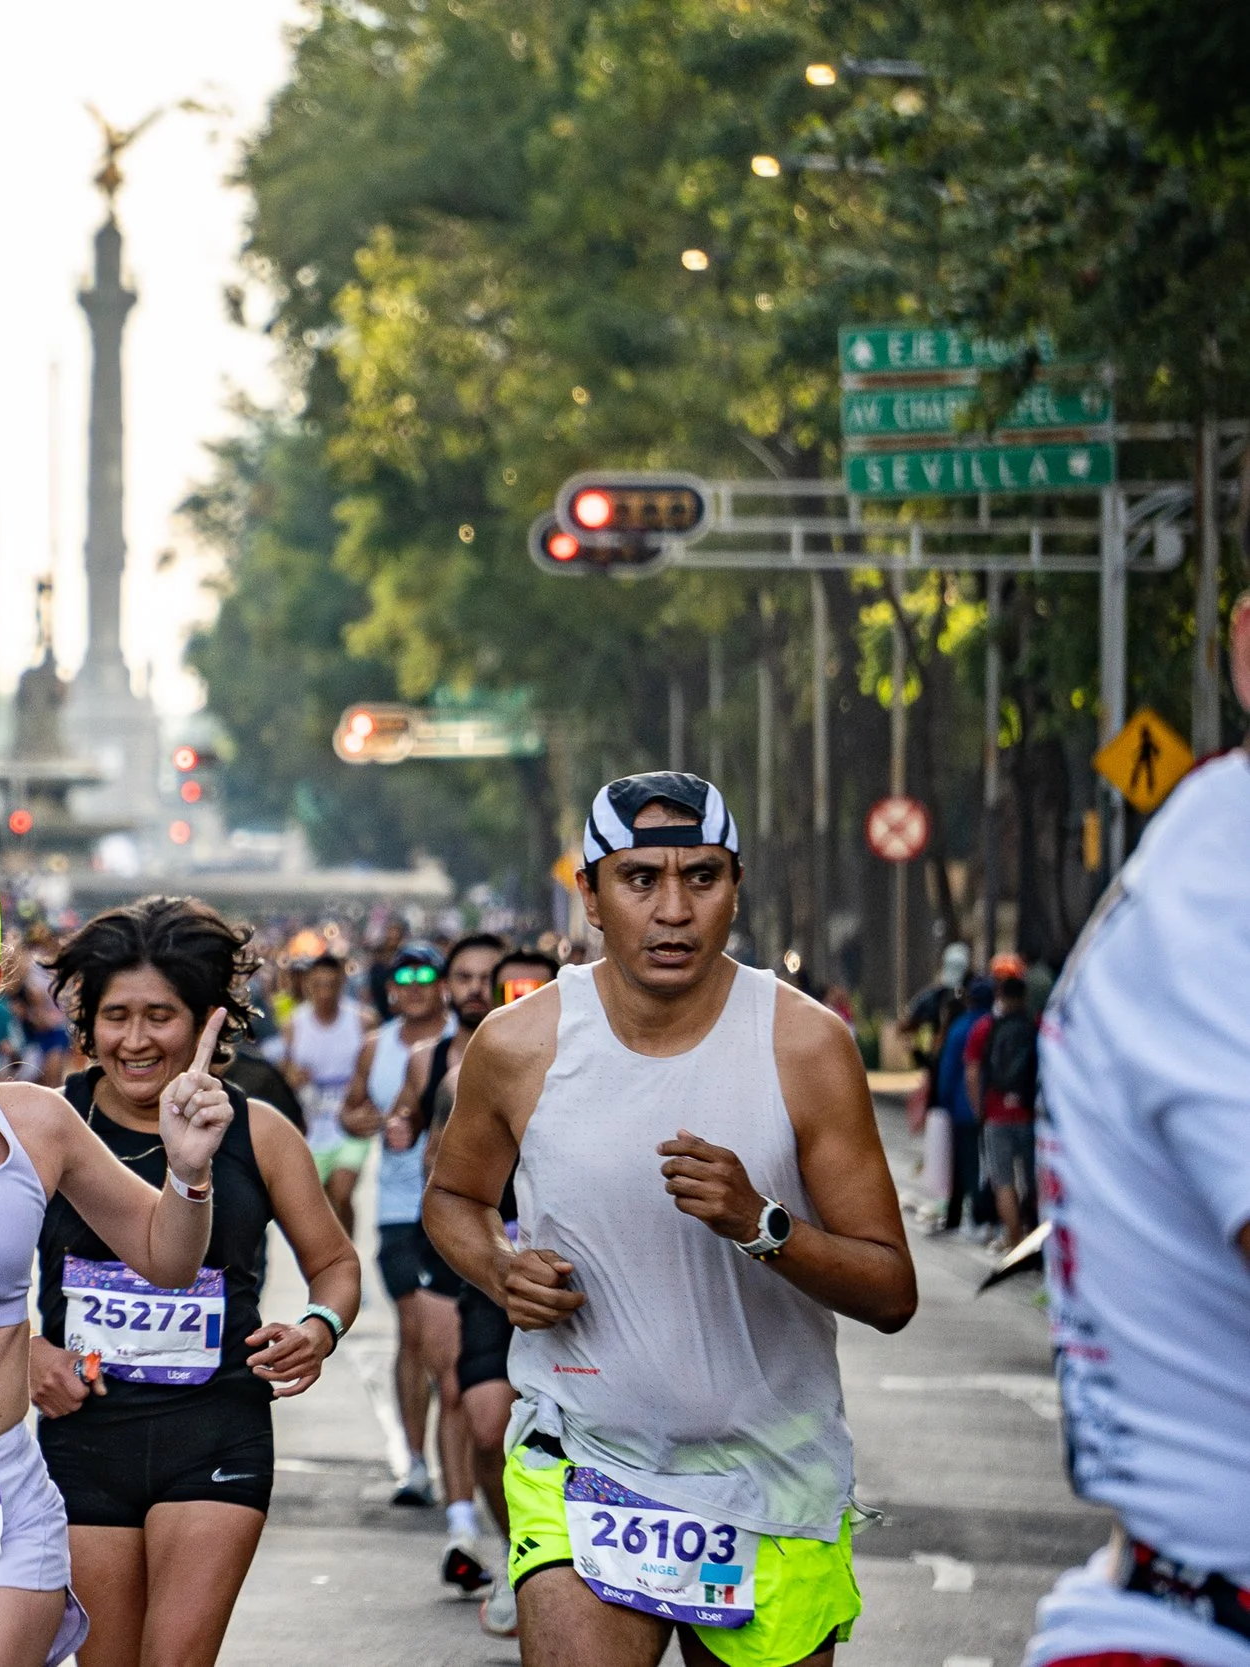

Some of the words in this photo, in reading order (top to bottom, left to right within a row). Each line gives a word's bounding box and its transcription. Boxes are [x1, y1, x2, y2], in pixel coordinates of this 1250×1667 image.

[865, 451, 1050, 491] SEVILLA
[82, 1295, 202, 1333] 25272
[591, 1510, 738, 1565] 26103
[640, 1561, 680, 1577] ANGEL
[602, 1586, 635, 1604] telcel
[695, 1609, 724, 1623] Uber
